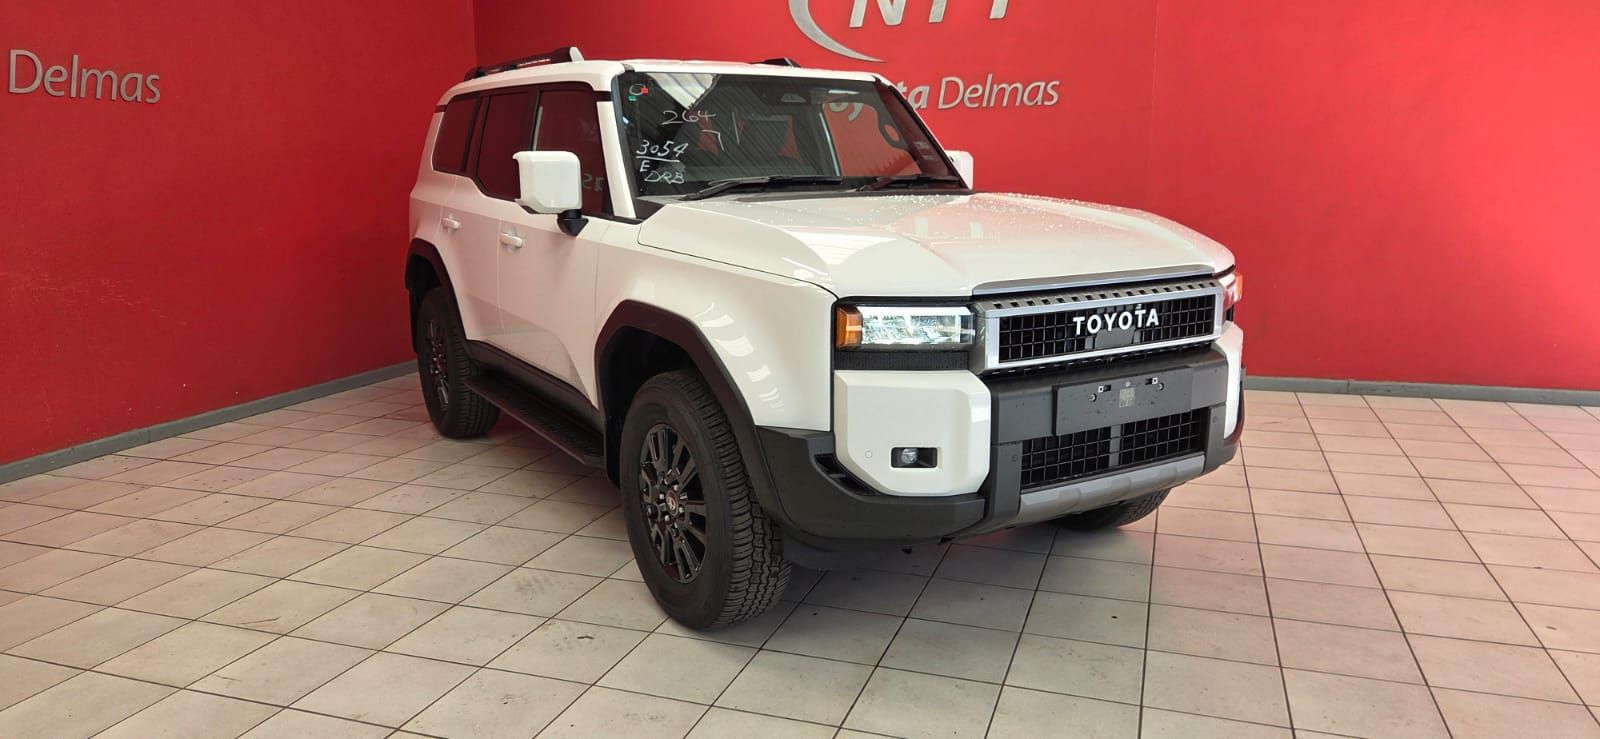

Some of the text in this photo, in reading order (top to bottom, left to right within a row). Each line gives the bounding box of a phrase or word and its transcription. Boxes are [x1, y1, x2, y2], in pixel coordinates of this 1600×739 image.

[9, 49, 161, 104] Delmas
[938, 74, 1060, 109] Delmas
[635, 139, 689, 158] 3054
[640, 160, 651, 172] E
[1073, 307, 1160, 336] TOYOTA
